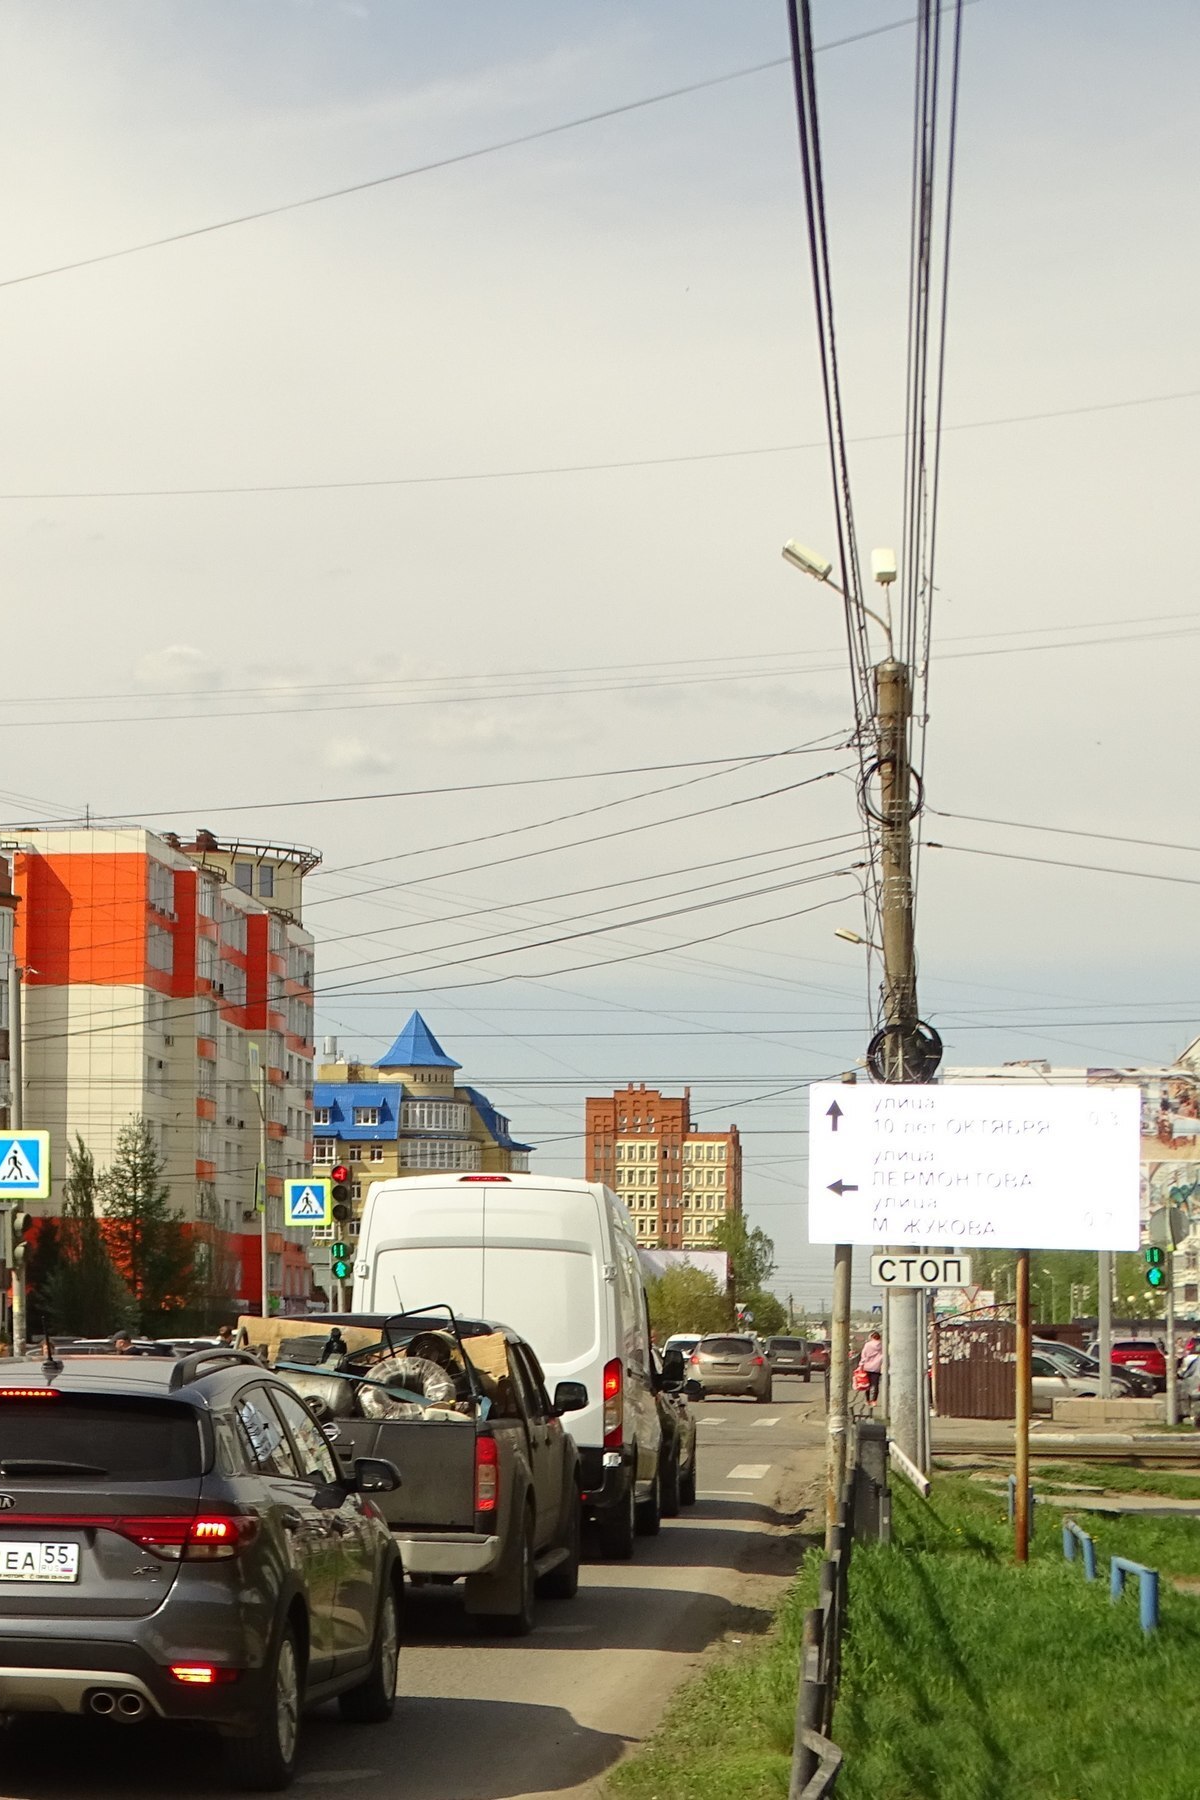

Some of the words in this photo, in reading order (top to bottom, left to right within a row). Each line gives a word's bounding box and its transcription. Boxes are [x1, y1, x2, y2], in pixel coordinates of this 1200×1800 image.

[874, 1118, 894, 1133] 10
[872, 1171, 1032, 1188] ЛЕРМОНТОВА
[903, 1218, 995, 1236] ЖУКОВА
[878, 1259, 961, 1282] СТОП
[44, 1545, 69, 1564] 55
